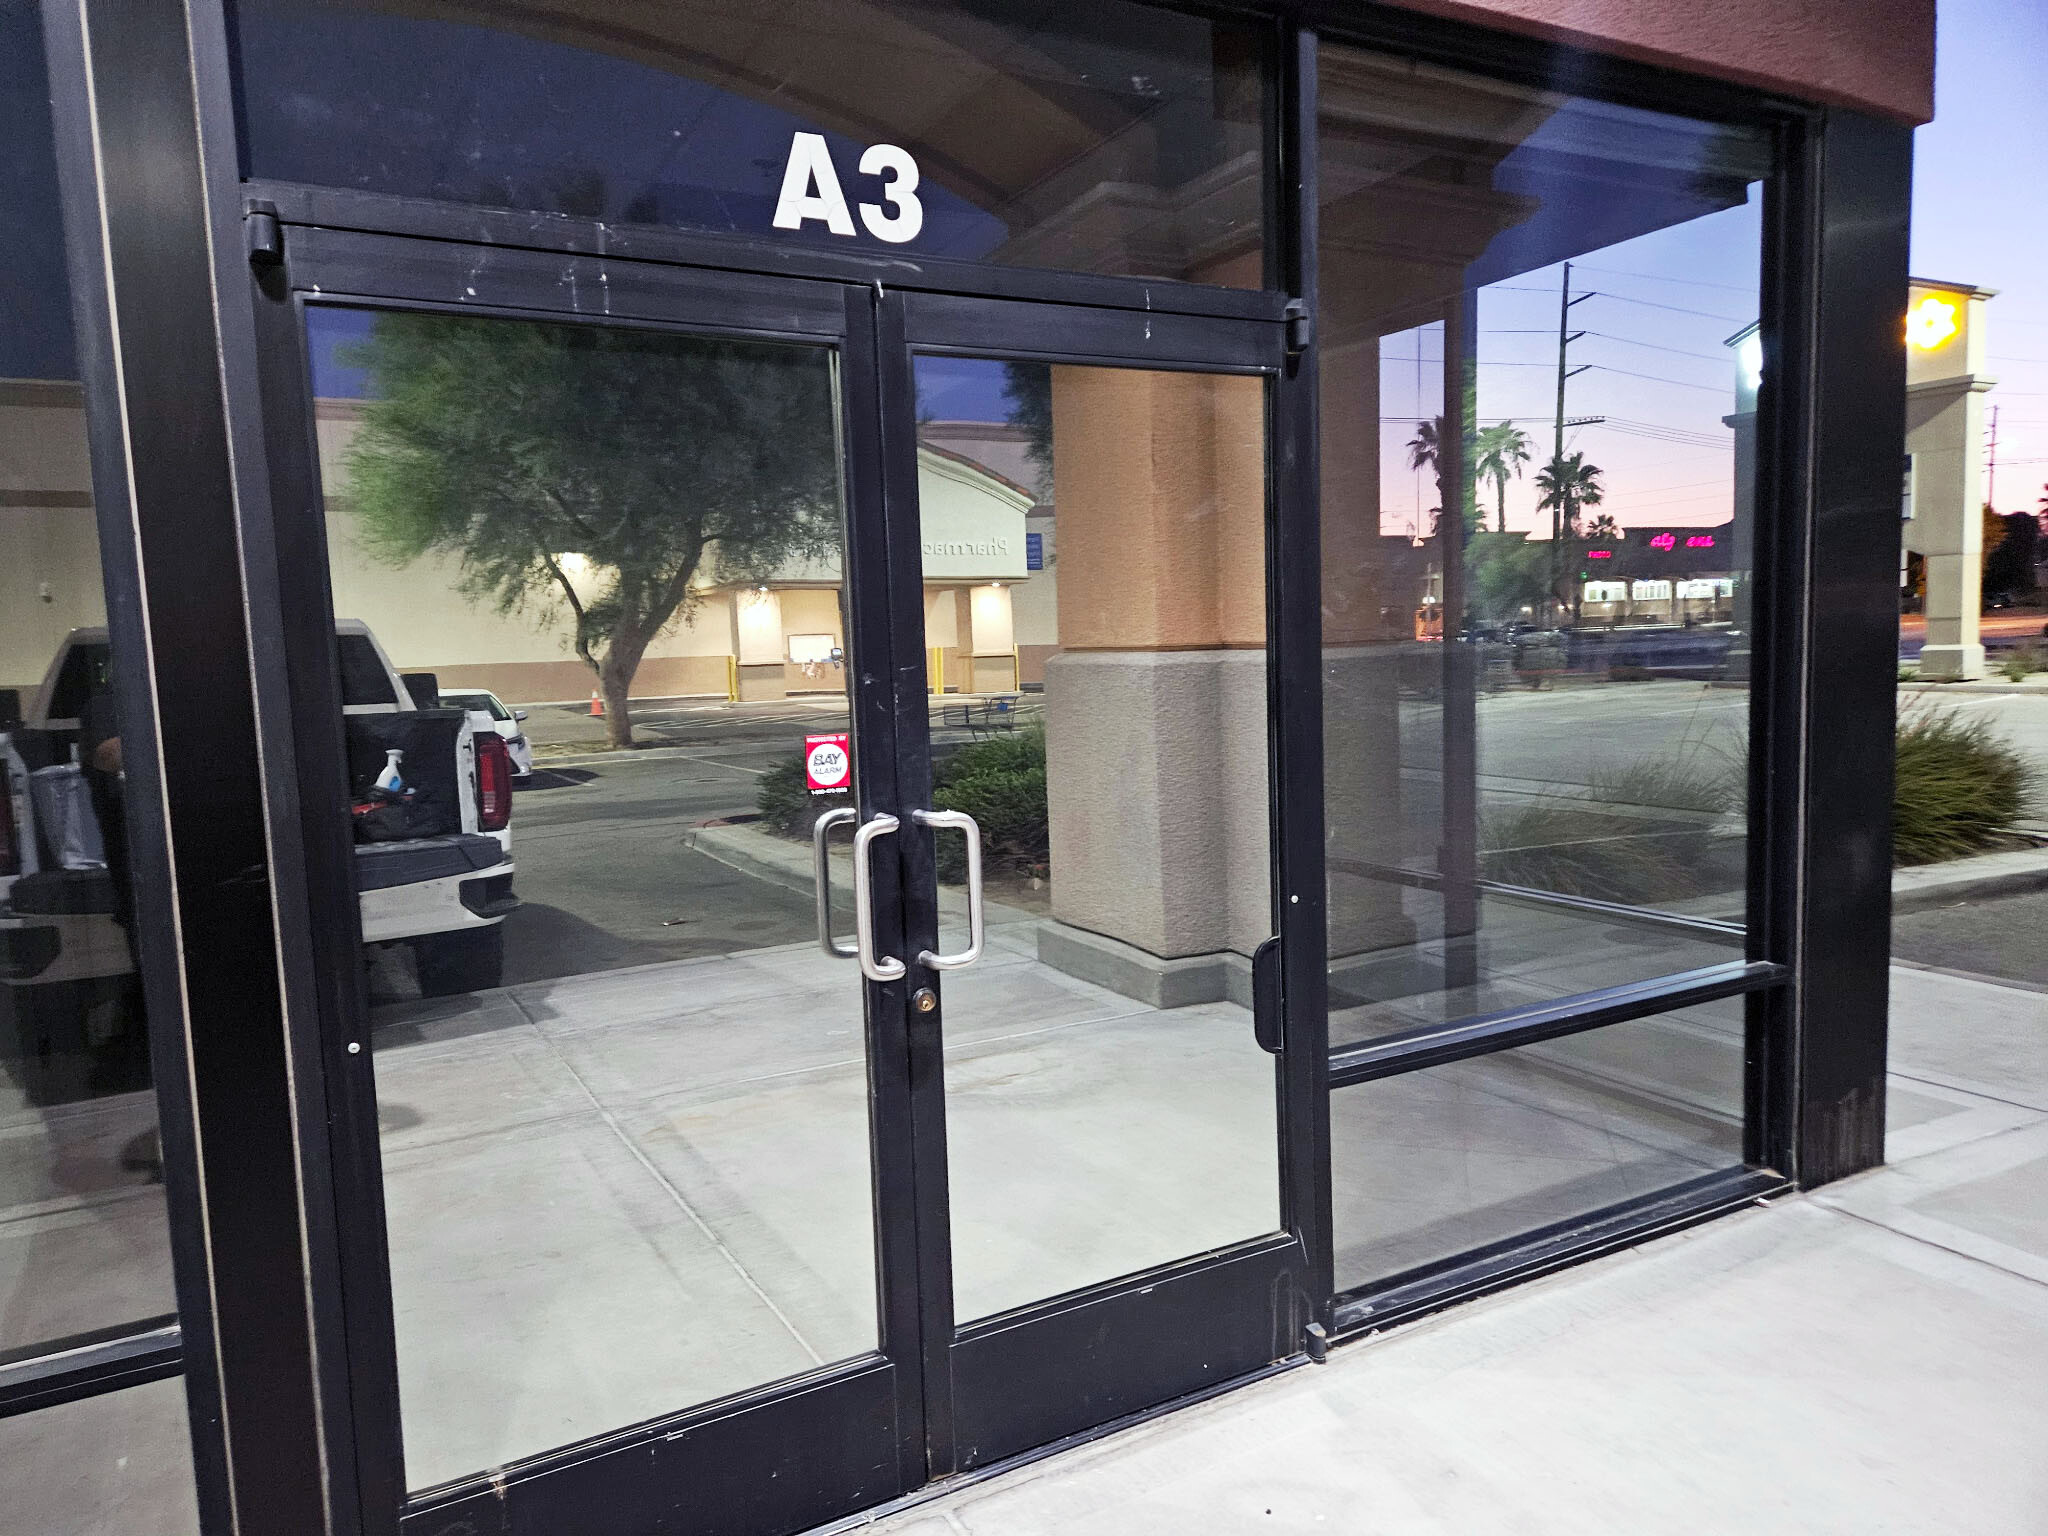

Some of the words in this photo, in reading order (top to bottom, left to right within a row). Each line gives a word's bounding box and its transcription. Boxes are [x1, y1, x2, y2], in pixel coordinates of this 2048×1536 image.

[772, 131, 924, 244] A3
[813, 753, 842, 766] BAY
[814, 766, 842, 774] ALARM
